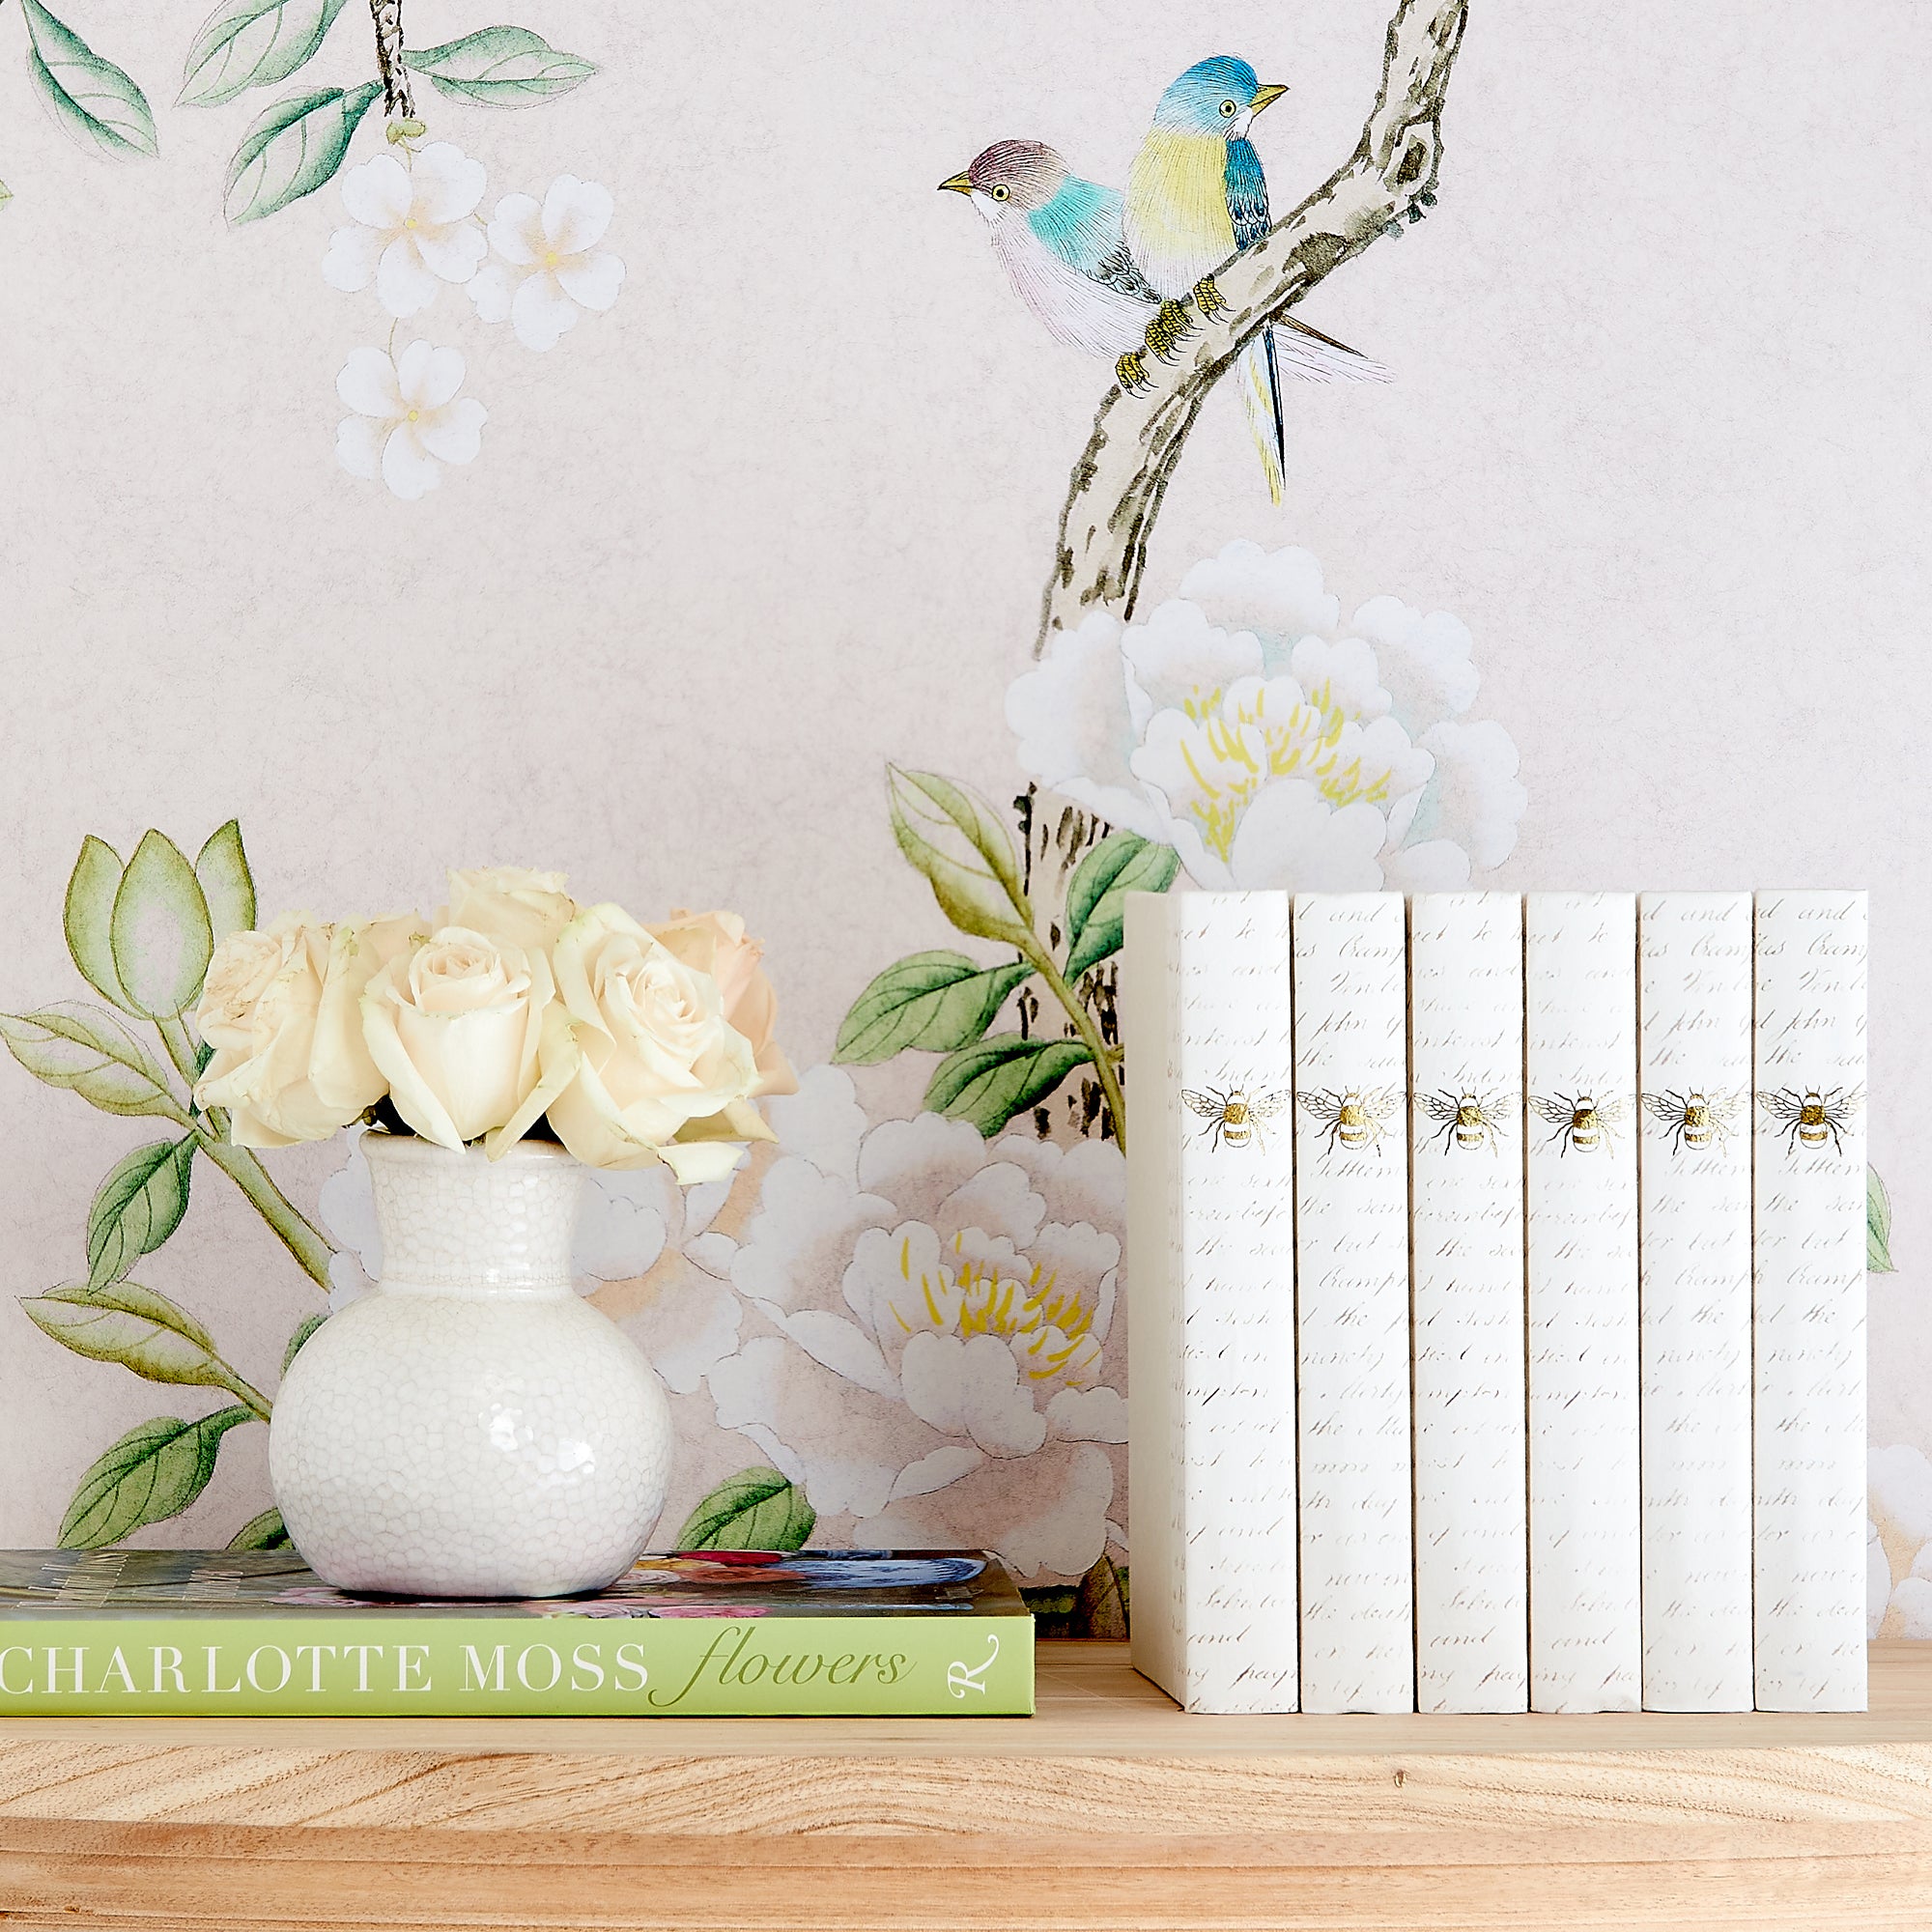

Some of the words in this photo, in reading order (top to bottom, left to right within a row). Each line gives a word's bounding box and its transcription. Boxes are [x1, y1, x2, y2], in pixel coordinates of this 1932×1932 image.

[0, 1644, 432, 1693] CHARLOTTE
[459, 1643, 648, 1691] MOSS
[647, 1626, 918, 1707] flowers
[947, 1634, 1000, 1699] R
